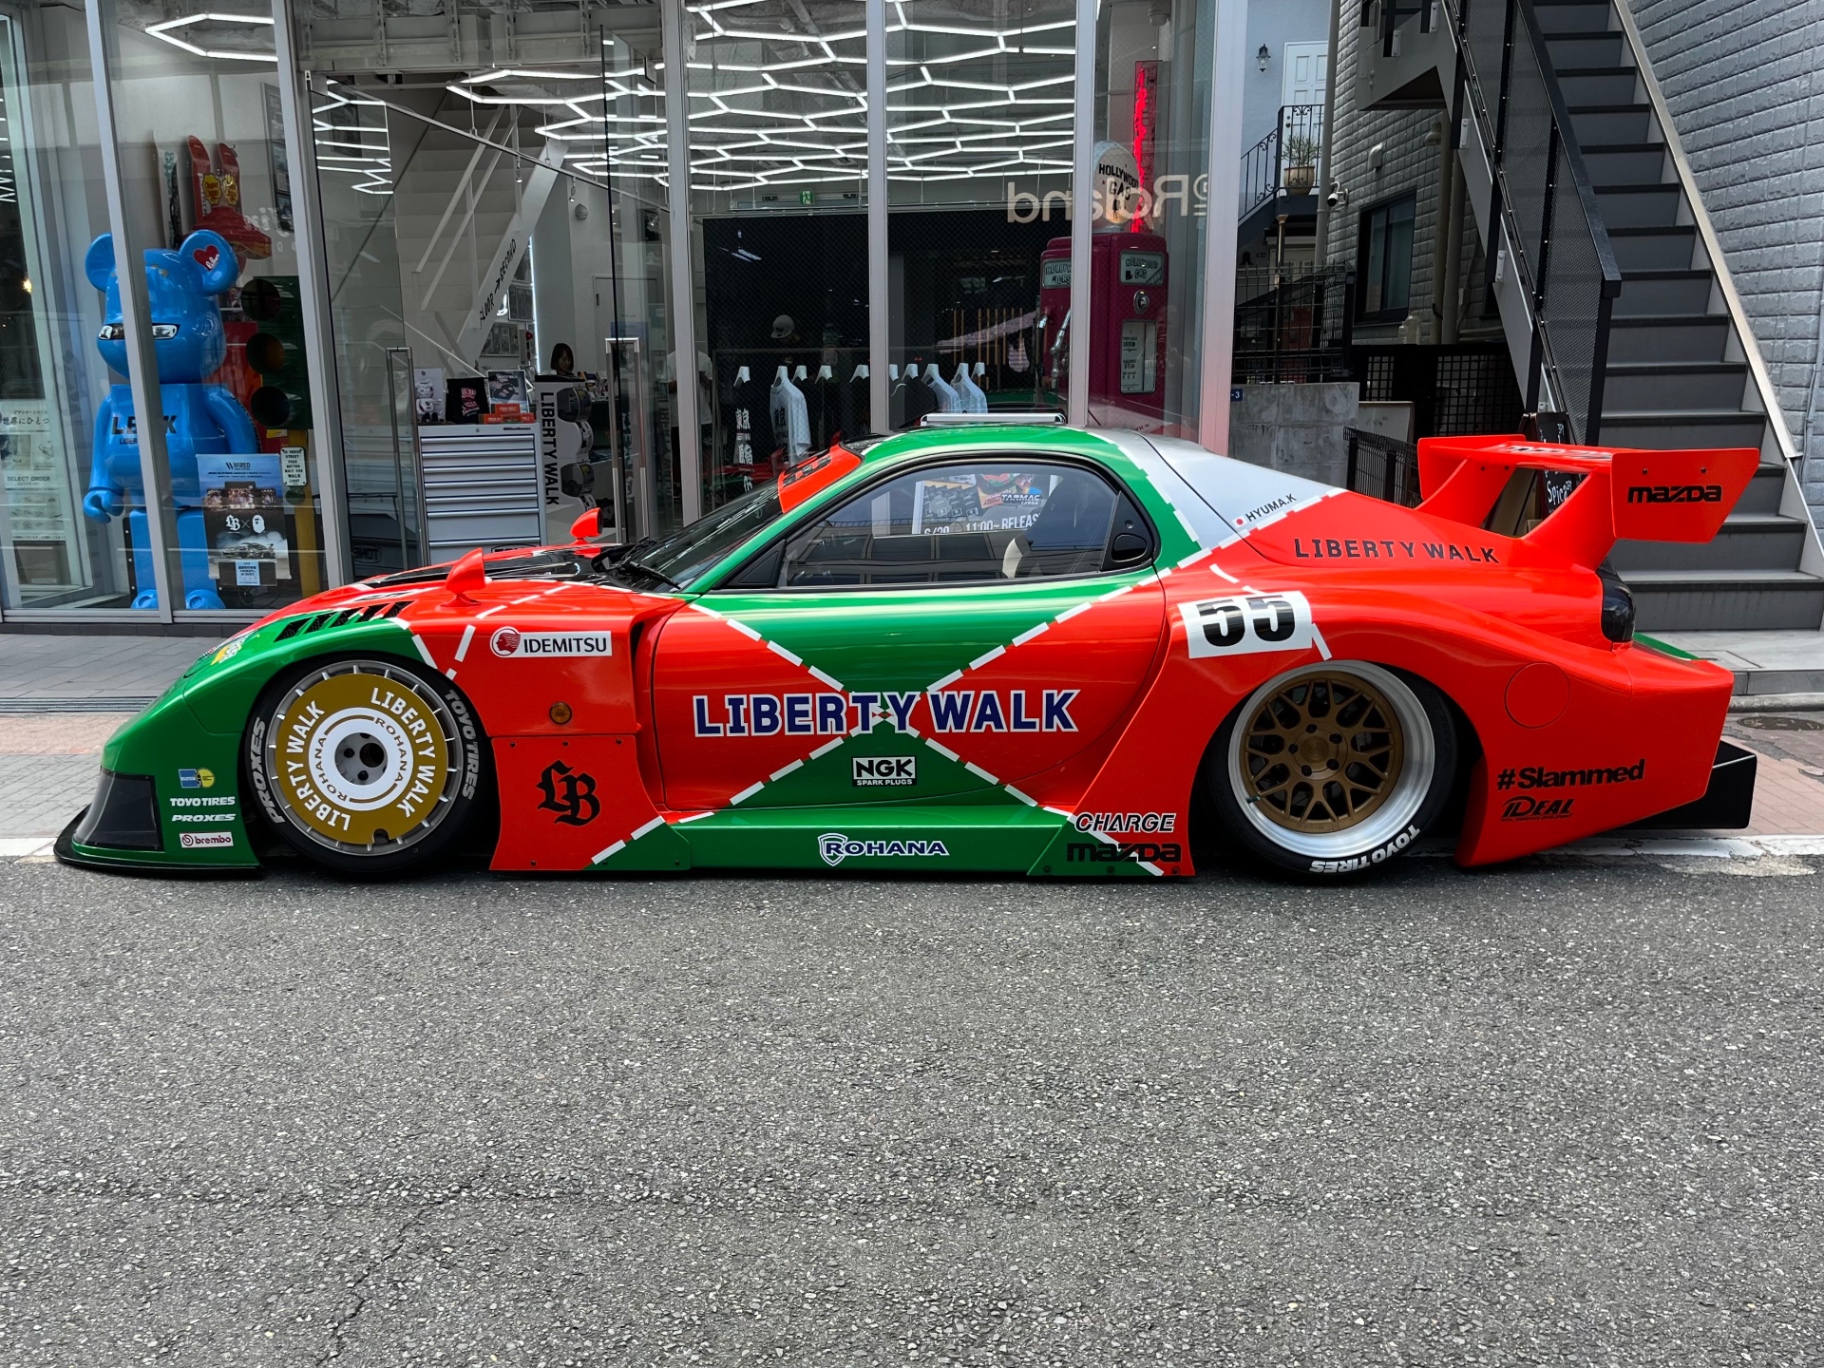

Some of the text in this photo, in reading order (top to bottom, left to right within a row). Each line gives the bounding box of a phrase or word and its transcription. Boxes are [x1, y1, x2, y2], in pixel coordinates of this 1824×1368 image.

[112, 416, 177, 434] LBK
[541, 391, 560, 505] LIBERTY WALK
[1002, 494, 1041, 502] TARMAC
[1245, 493, 1297, 522] HYUMA.K
[1294, 538, 1499, 564] LIBERTY WALK
[1196, 595, 1295, 647] 55
[524, 637, 607, 654] IDEMITSU
[693, 689, 1080, 737] LIBERTY WALK
[370, 687, 436, 818] LIBERTY WALK
[374, 717, 408, 782] ROHANA
[444, 689, 480, 800] TOYO TIRES
[250, 716, 286, 824] PROXES
[287, 700, 351, 831] LIBERTY WALK
[315, 737, 348, 802] ROHANA
[855, 758, 914, 778] NGK
[1497, 758, 1647, 790] #Slammed
[170, 796, 236, 807] TOYO TIRES
[172, 813, 236, 822] PROXES
[1074, 812, 1176, 833] CHARGE
[194, 835, 232, 845] brembo
[823, 838, 950, 858] ROHANA
[1309, 824, 1420, 873] TOYO TIRES
